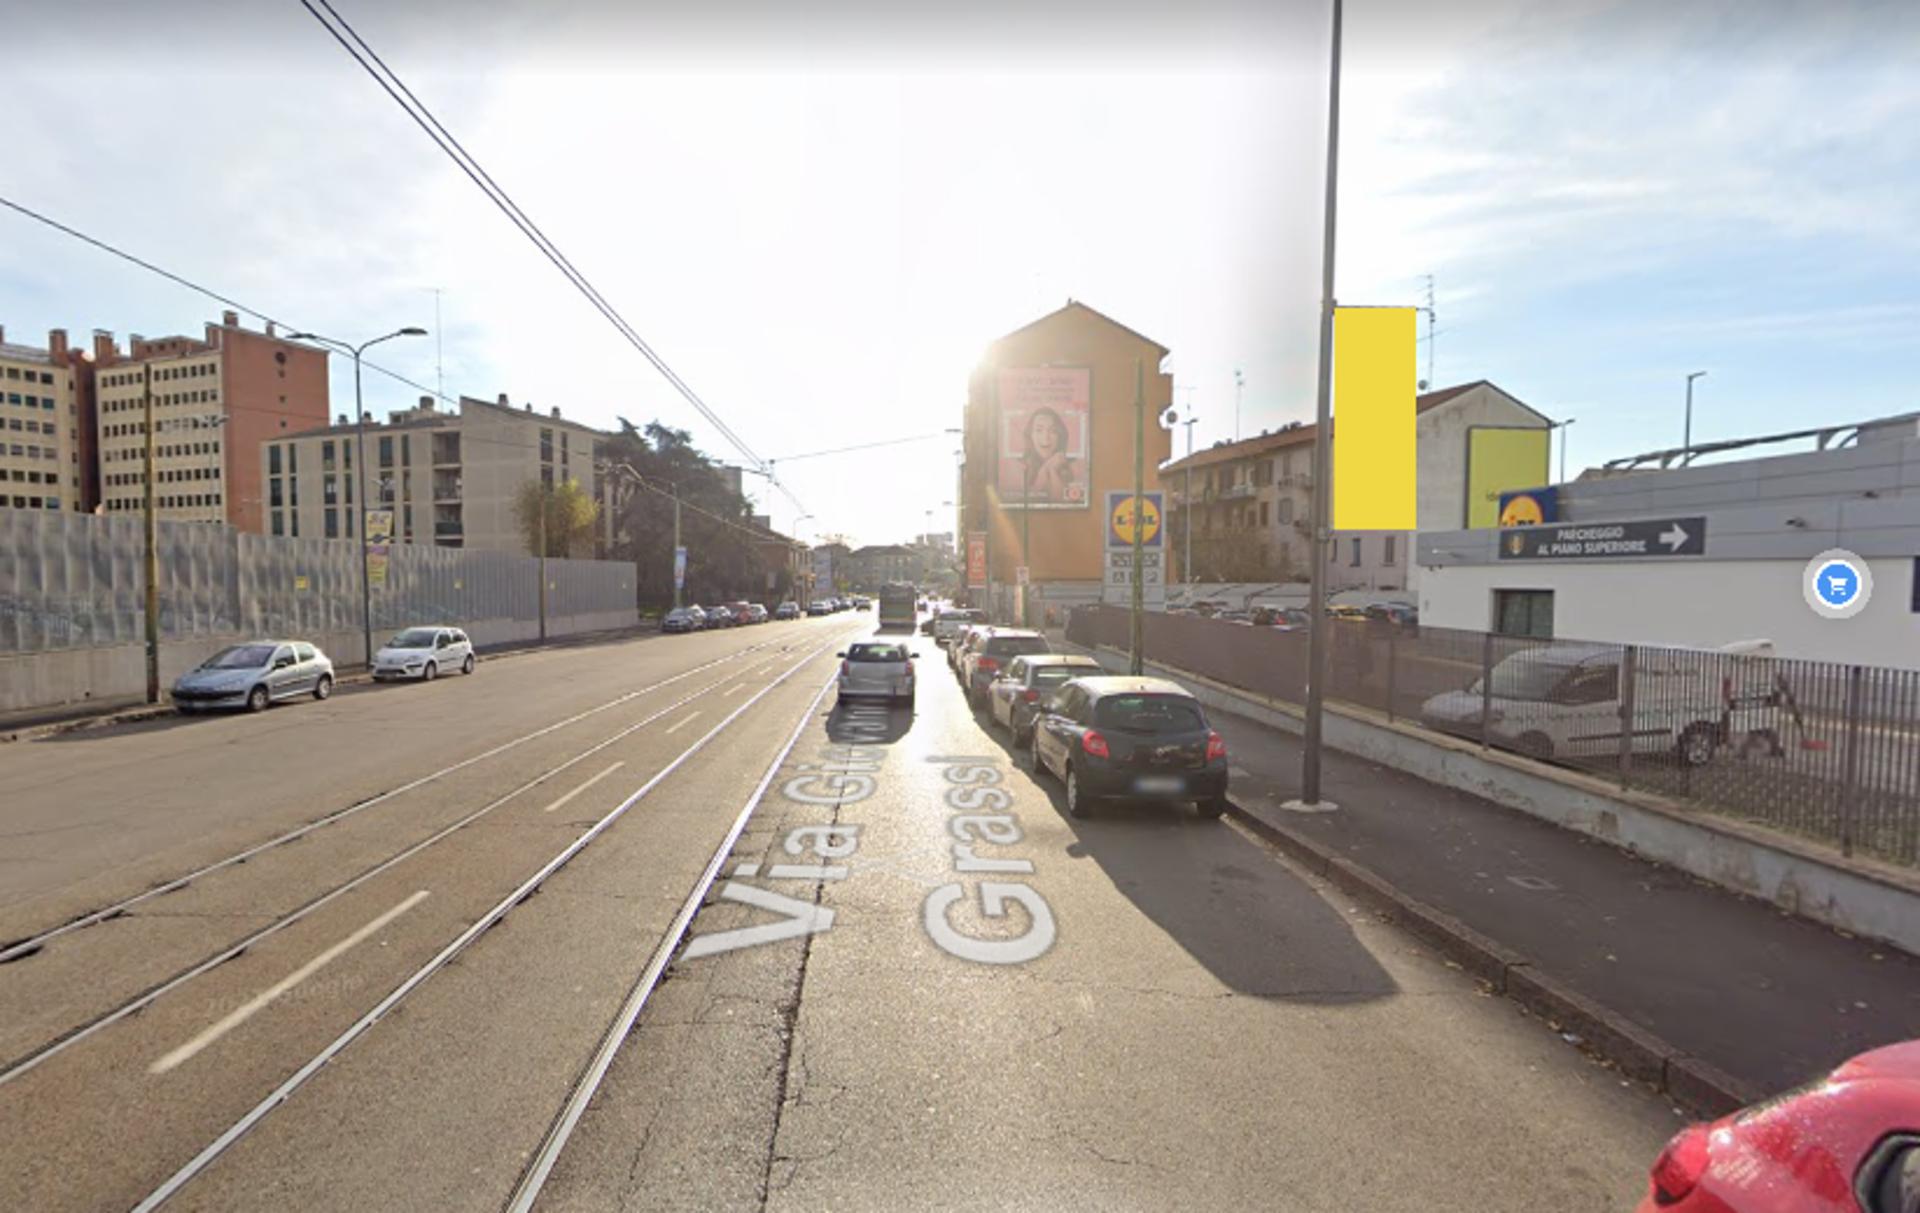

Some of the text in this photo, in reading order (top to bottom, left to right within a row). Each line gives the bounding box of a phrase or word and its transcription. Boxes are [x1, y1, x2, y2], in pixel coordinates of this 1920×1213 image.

[1557, 526, 1624, 541] PARCHEGGIO
[1537, 540, 1646, 555] AL PIANO SUPERIORE
